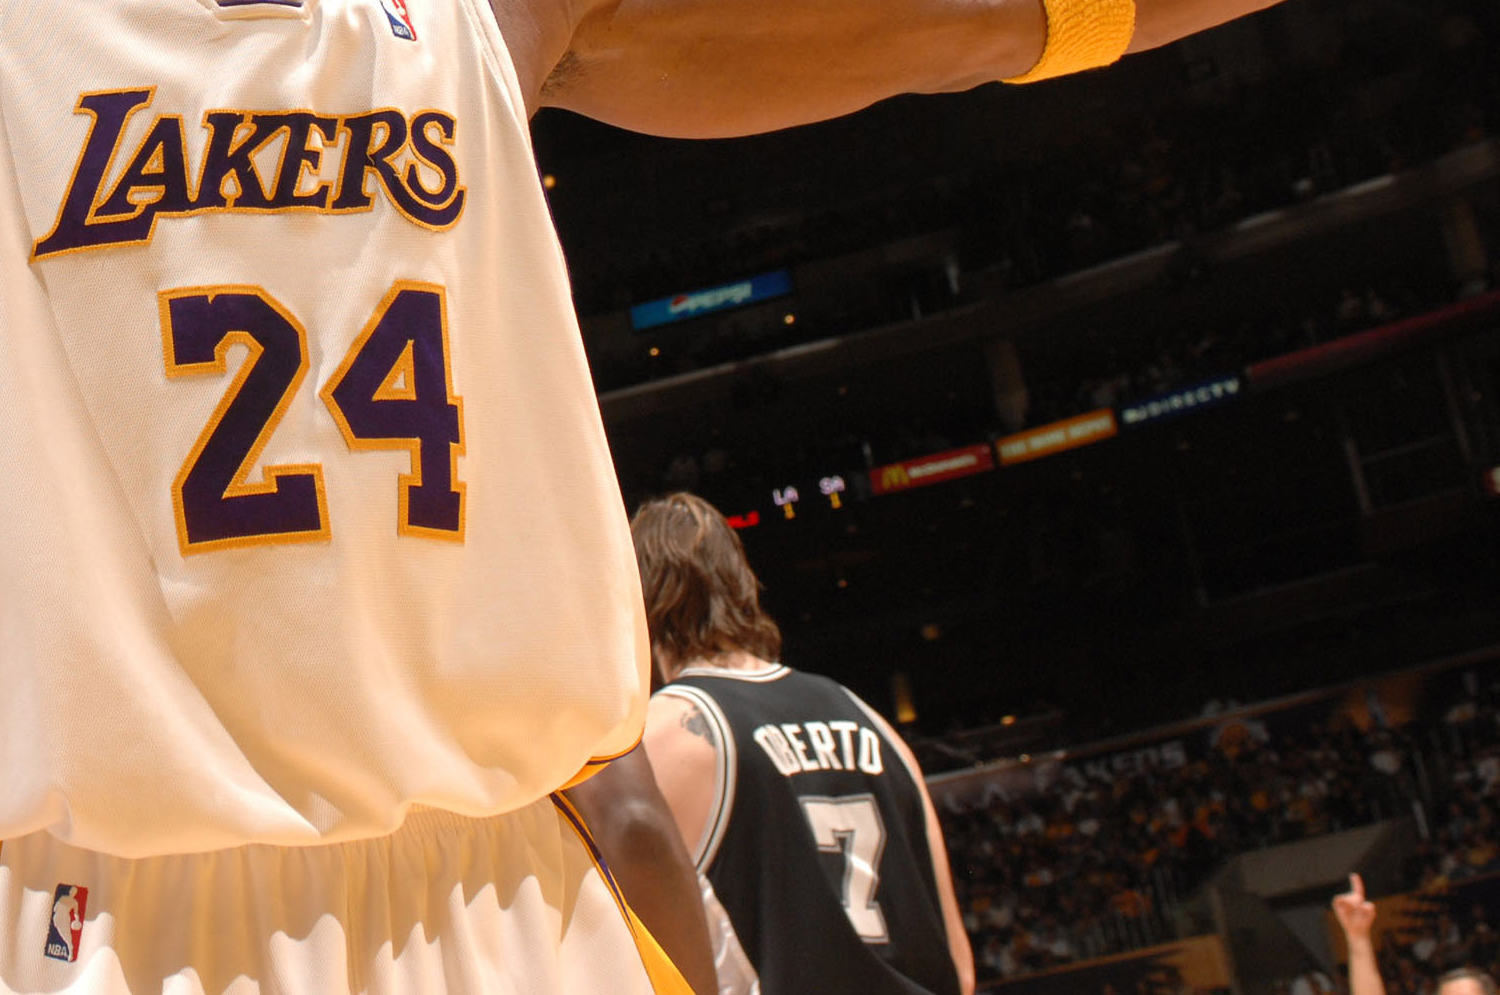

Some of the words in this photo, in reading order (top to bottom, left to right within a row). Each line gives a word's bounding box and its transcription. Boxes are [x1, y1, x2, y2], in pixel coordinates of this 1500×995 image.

[30, 85, 467, 264] LAKERS
[158, 279, 466, 556] 24
[753, 720, 884, 776] OBERTO
[798, 793, 890, 943] 7
[47, 943, 69, 957] NBA
